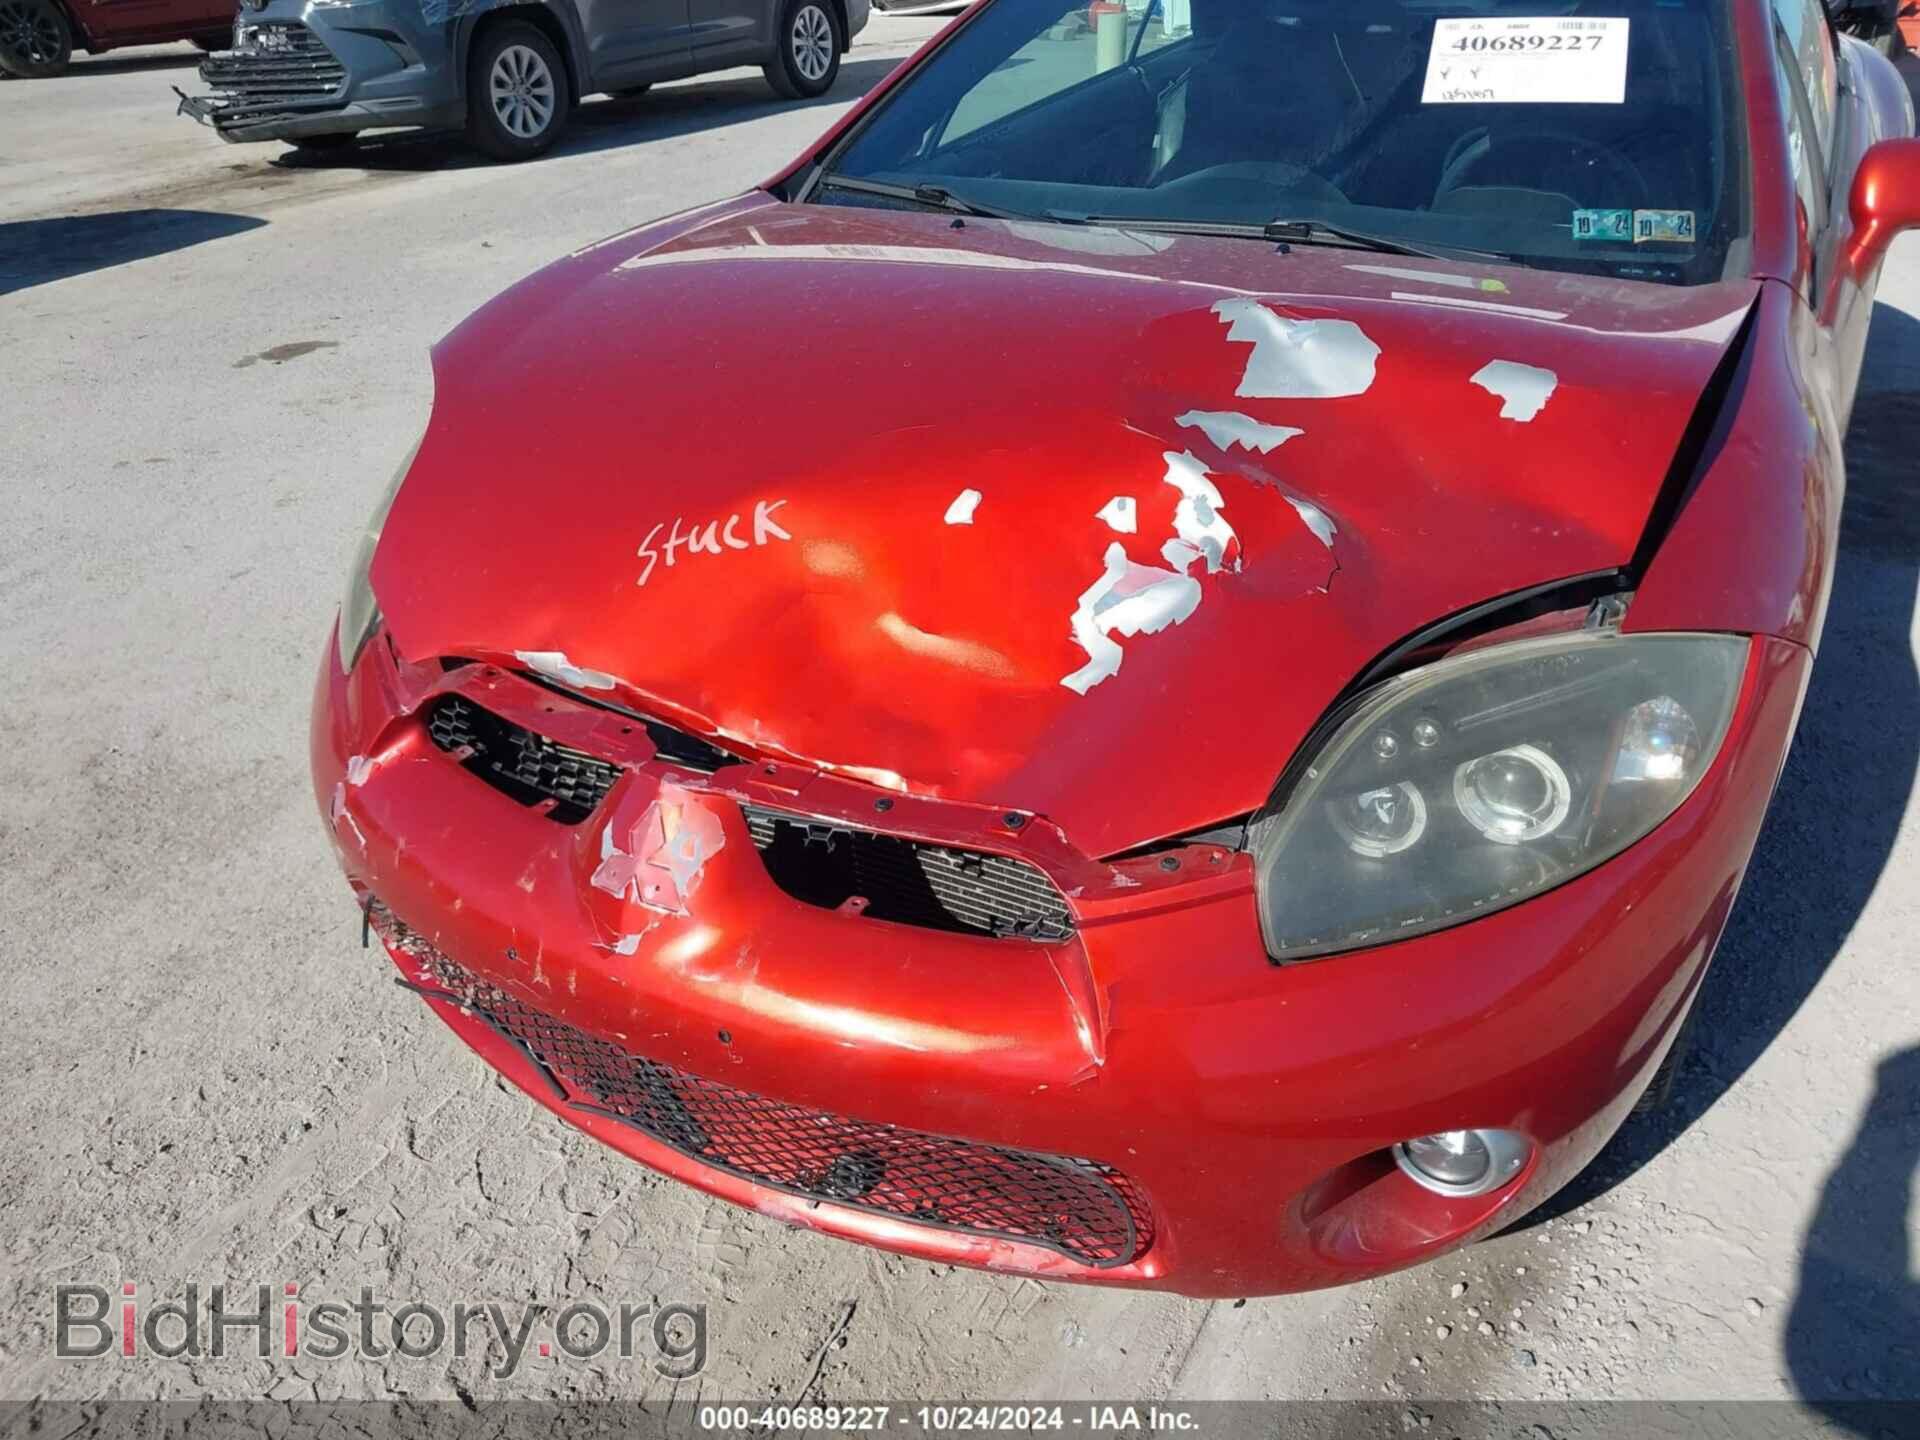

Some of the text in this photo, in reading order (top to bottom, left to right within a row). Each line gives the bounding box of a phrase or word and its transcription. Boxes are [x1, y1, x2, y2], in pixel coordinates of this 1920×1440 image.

[1451, 35, 1603, 51] 40689227
[1616, 214, 1629, 234] 24
[1640, 216, 1692, 237] 10 24
